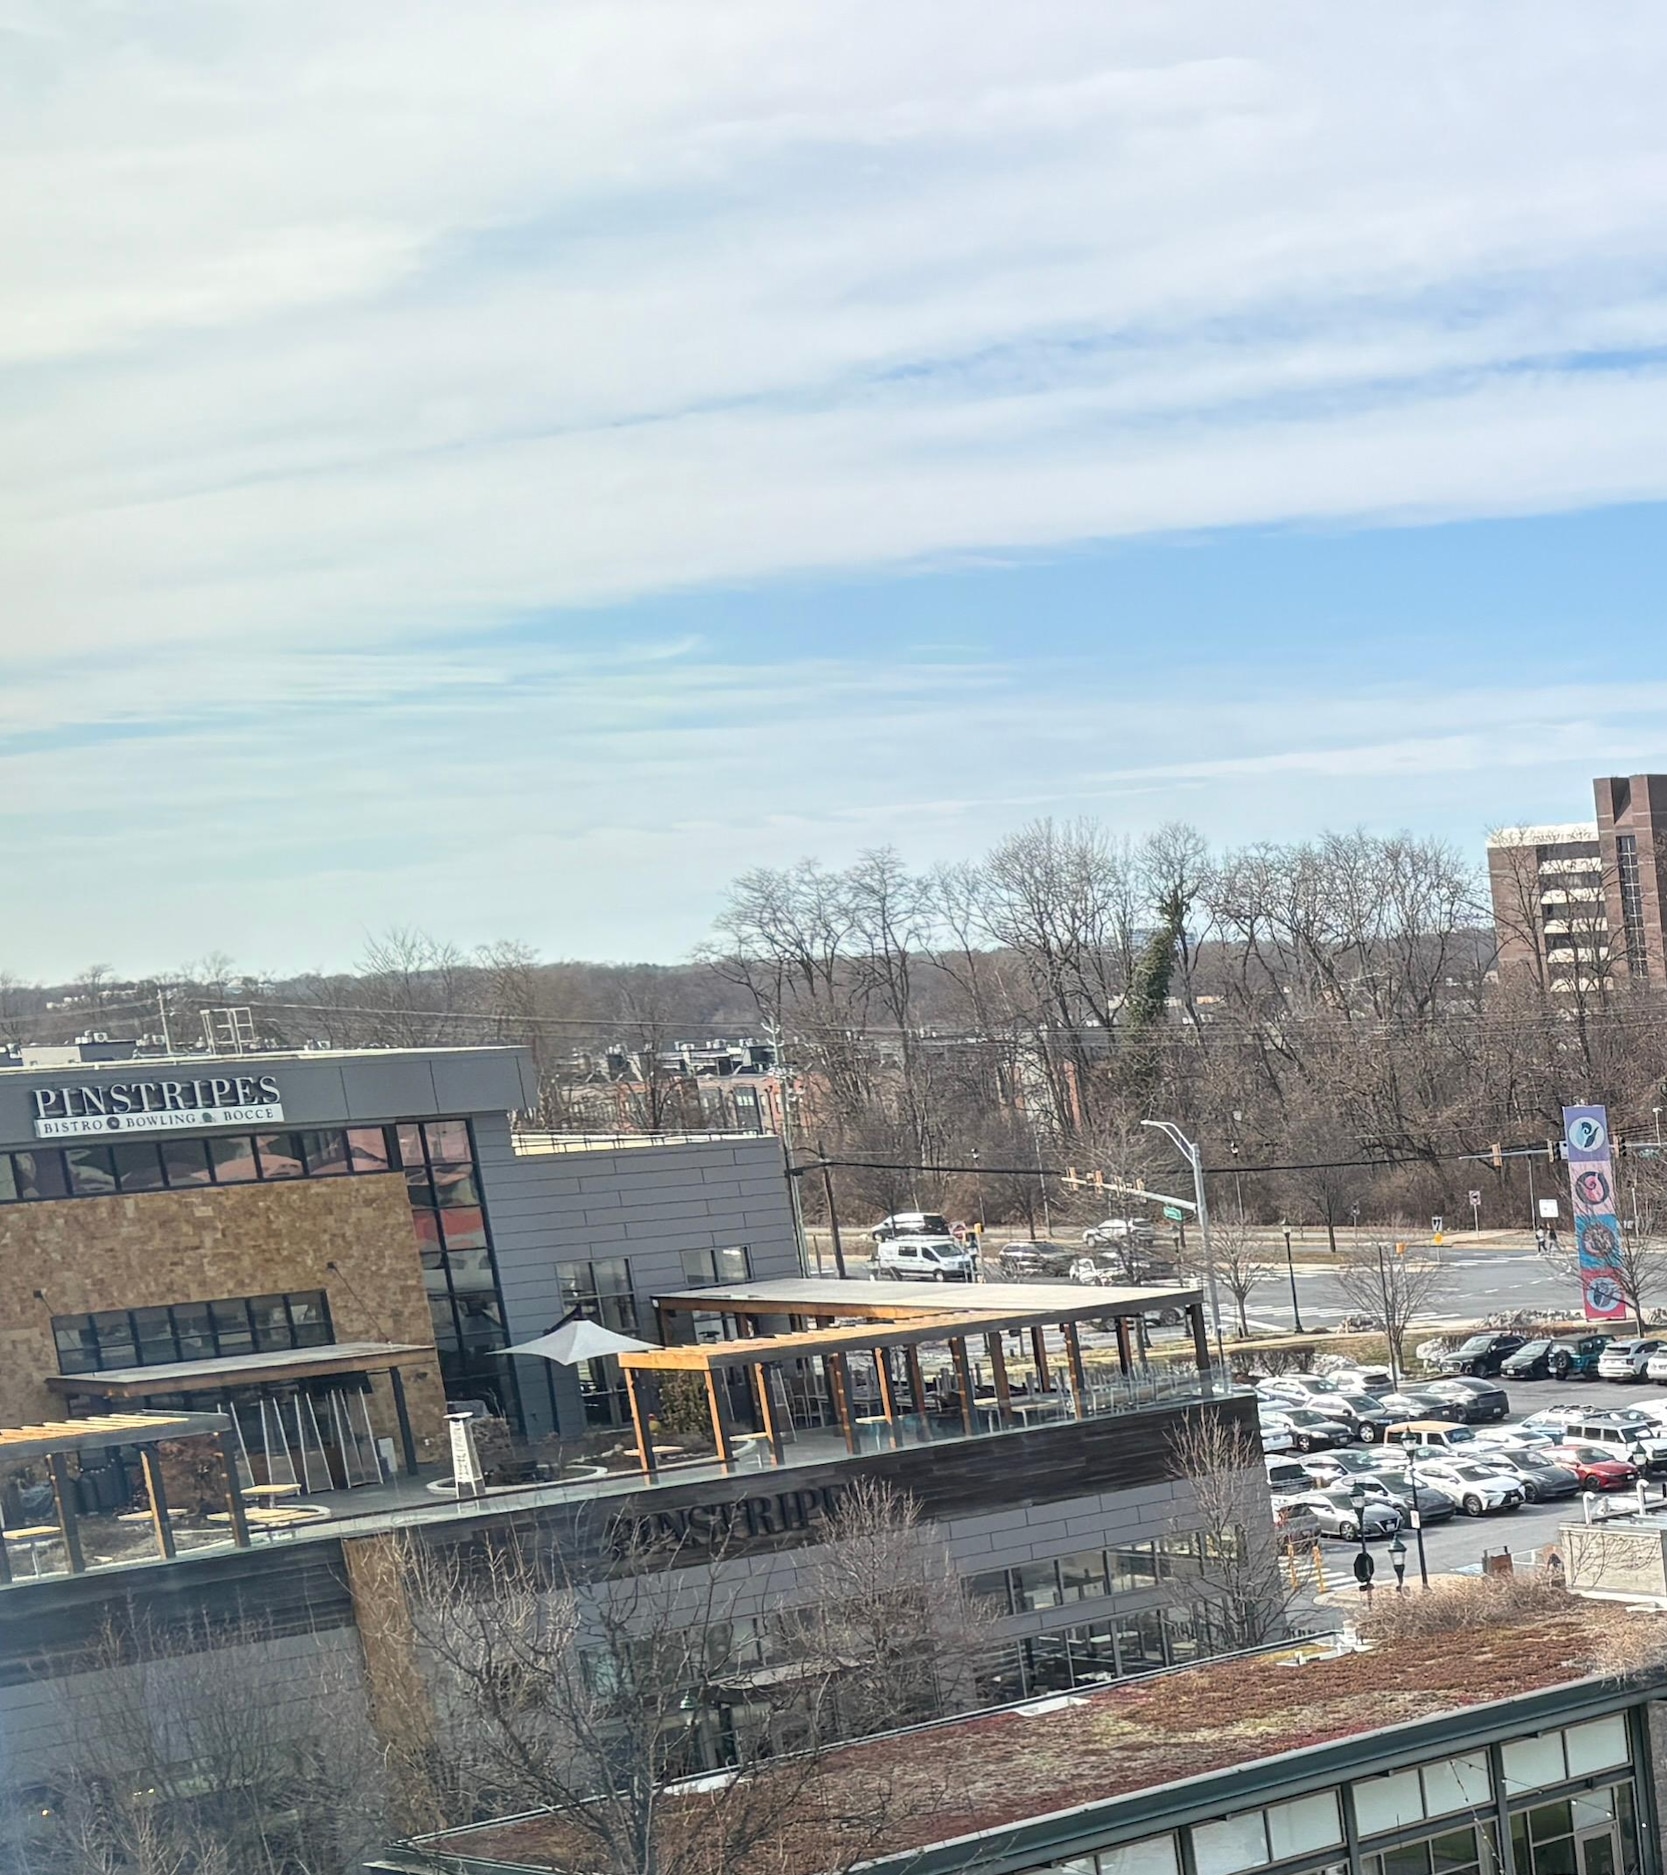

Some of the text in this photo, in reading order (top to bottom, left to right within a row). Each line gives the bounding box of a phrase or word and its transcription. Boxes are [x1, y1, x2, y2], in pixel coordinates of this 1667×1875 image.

[33, 1075, 281, 1118] PINSTRIPES
[43, 1107, 274, 1134] BISTRO BOWLING BOCCE
